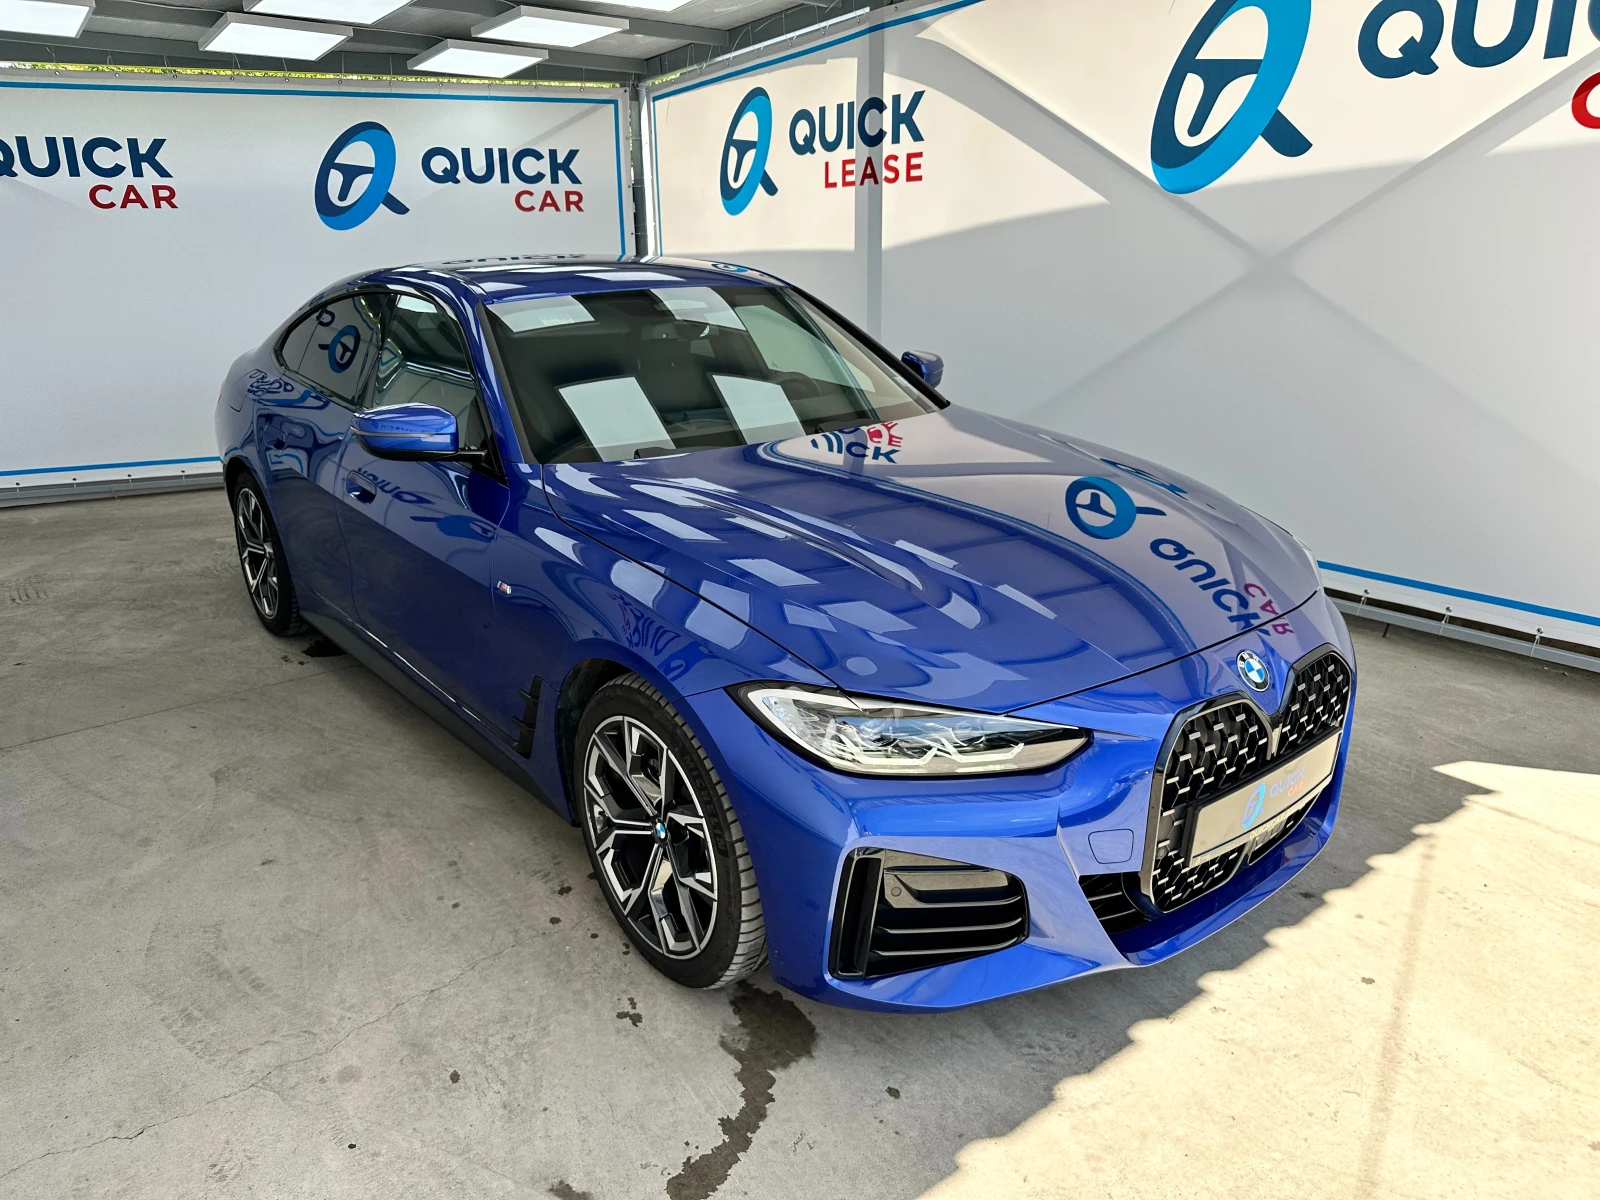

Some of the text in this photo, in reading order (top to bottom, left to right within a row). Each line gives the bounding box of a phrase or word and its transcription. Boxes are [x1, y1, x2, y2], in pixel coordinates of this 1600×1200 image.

[1358, 0, 1600, 79] QUI
[788, 89, 926, 156] QUICK
[421, 146, 583, 184] QUICK
[824, 151, 924, 189] LEASE
[88, 183, 179, 210] CAR
[514, 189, 585, 213] CAR
[1270, 768, 1305, 798] QUICK
[1287, 780, 1305, 797] CAR
